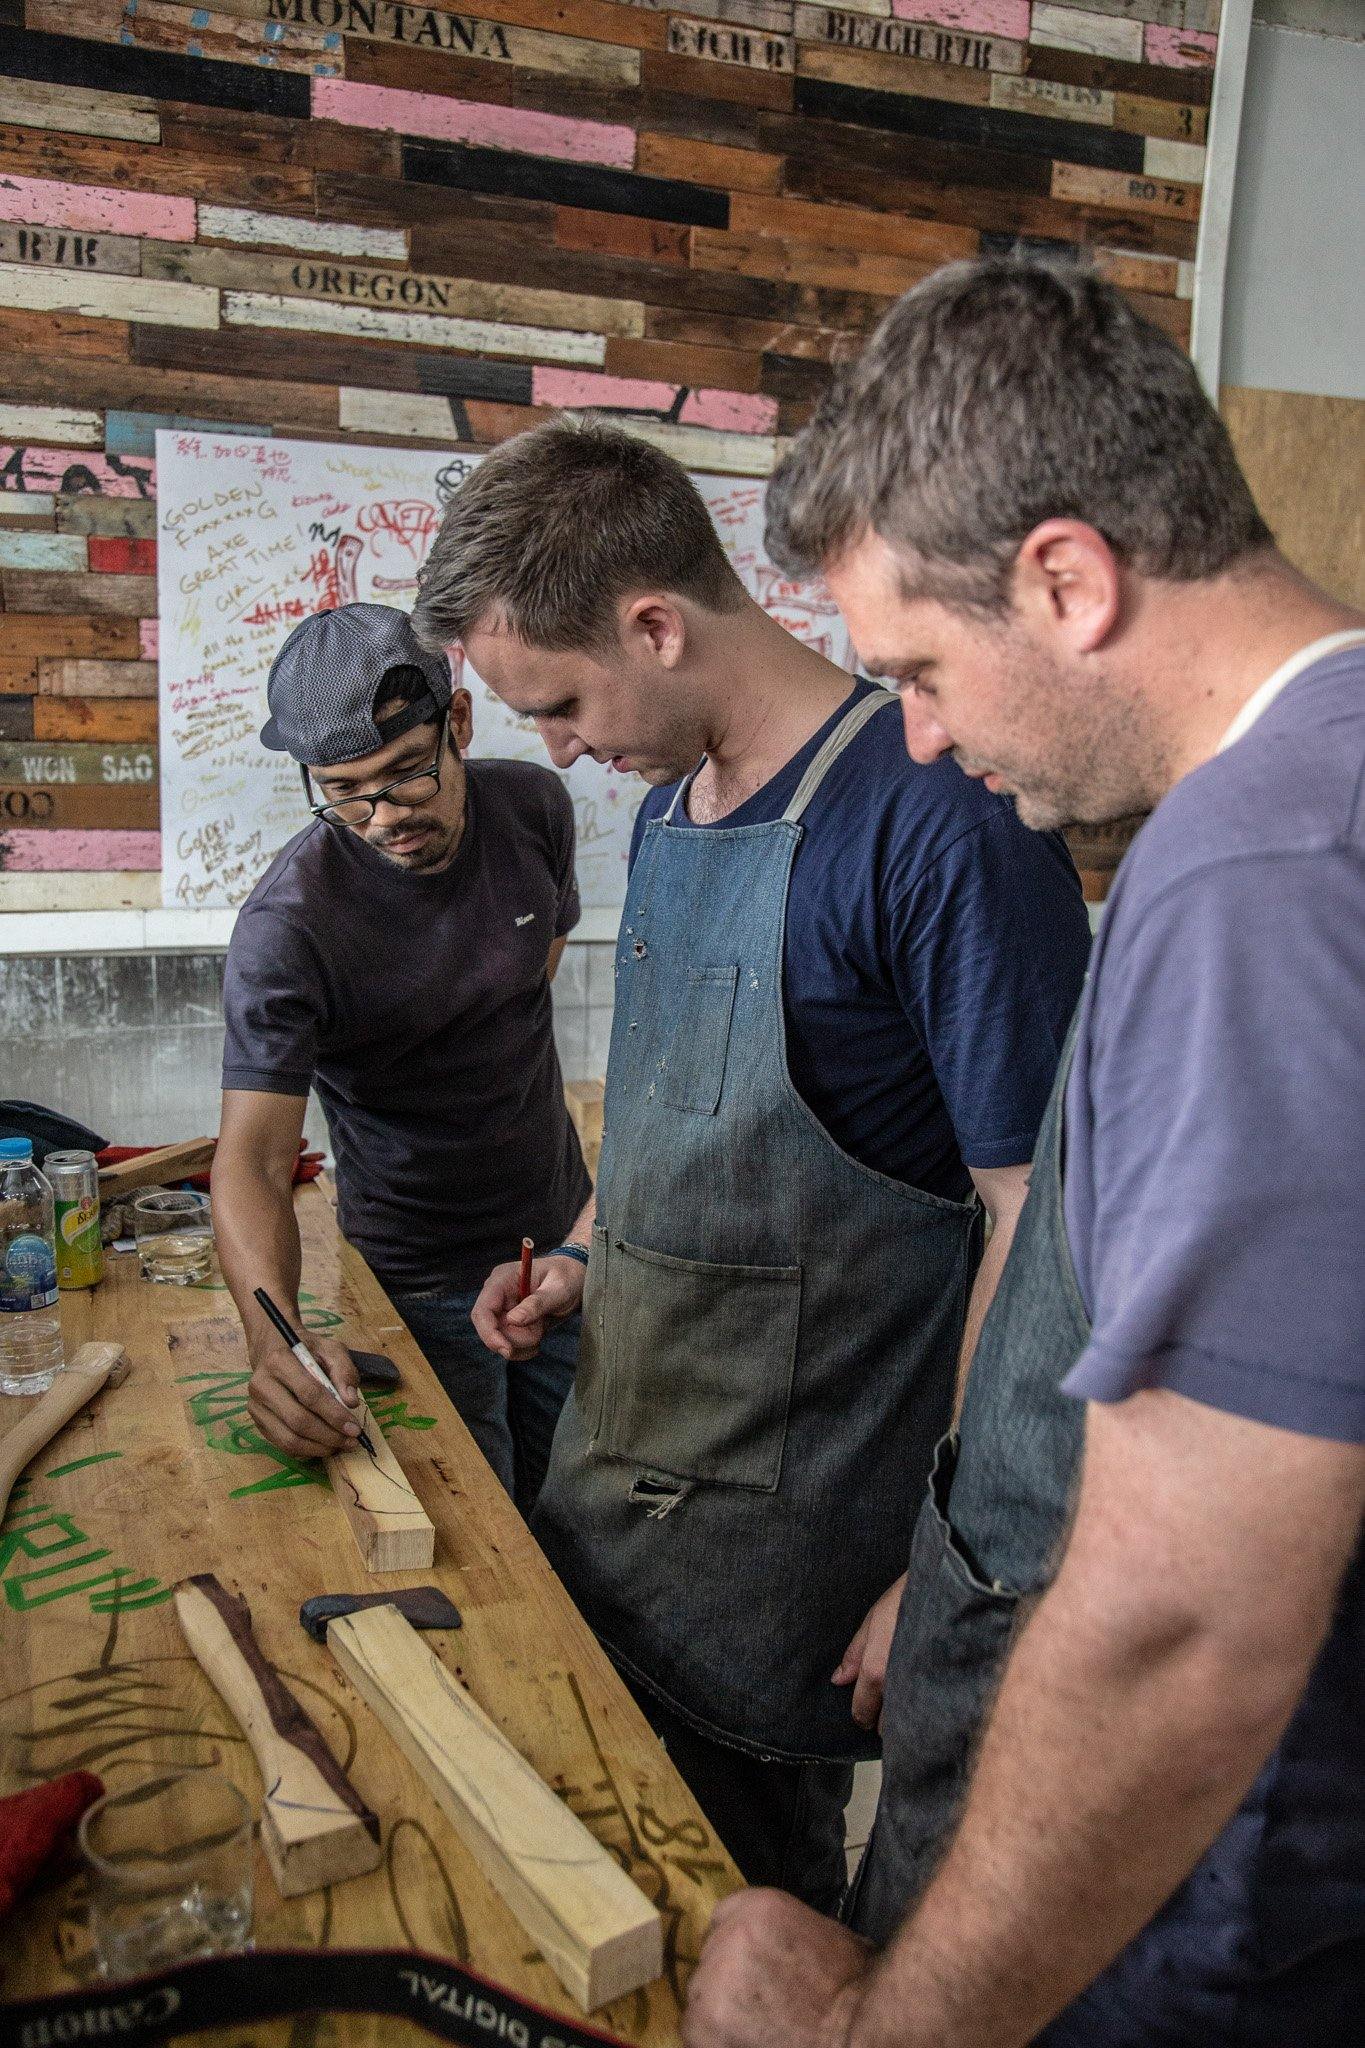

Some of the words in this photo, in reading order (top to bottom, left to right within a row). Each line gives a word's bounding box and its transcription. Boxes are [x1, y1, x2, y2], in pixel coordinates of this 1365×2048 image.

[267, 0, 513, 59] MONTANA
[291, 265, 452, 308] OREGON
[165, 481, 263, 527] GOLDEN
[207, 533, 248, 562] AXE
[179, 556, 239, 594] GREAT
[21, 1985, 181, 2048] Canon
[400, 1971, 530, 2048] DIGITAL
